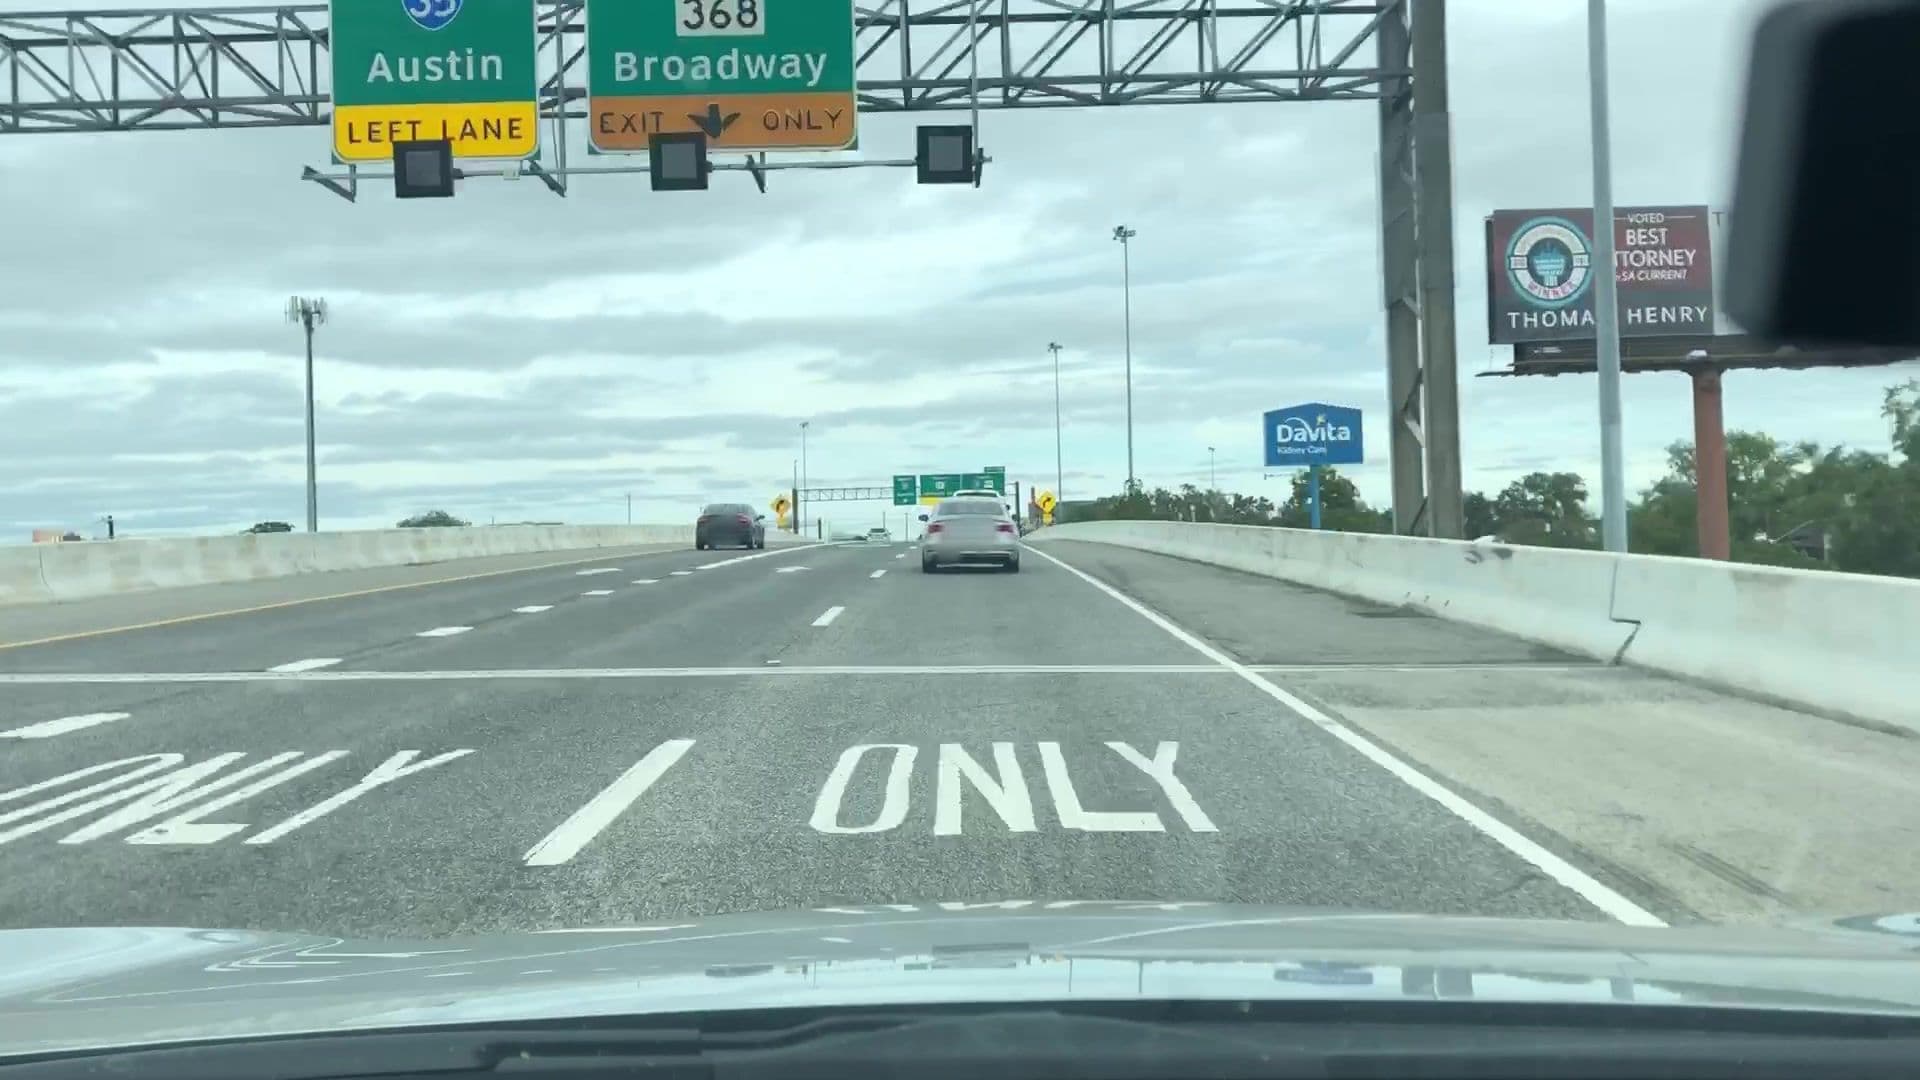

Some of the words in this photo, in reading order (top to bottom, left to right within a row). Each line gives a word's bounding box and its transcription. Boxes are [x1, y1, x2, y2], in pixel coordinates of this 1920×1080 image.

[683, 0, 759, 30] 368
[367, 48, 503, 83] Austin
[614, 48, 827, 87] Broadway
[347, 120, 422, 144] LEFT
[441, 118, 523, 141] LANE
[599, 112, 664, 134] EXIT
[762, 108, 844, 131] ONLY
[1627, 213, 1665, 224] VOTED
[1626, 228, 1668, 245] BEST
[1614, 249, 1697, 267] TTORNEY
[1507, 310, 1597, 329] THOMA
[1627, 306, 1708, 324] HENRY
[0, 749, 477, 845] ONLY
[809, 741, 1220, 835] ONLY
